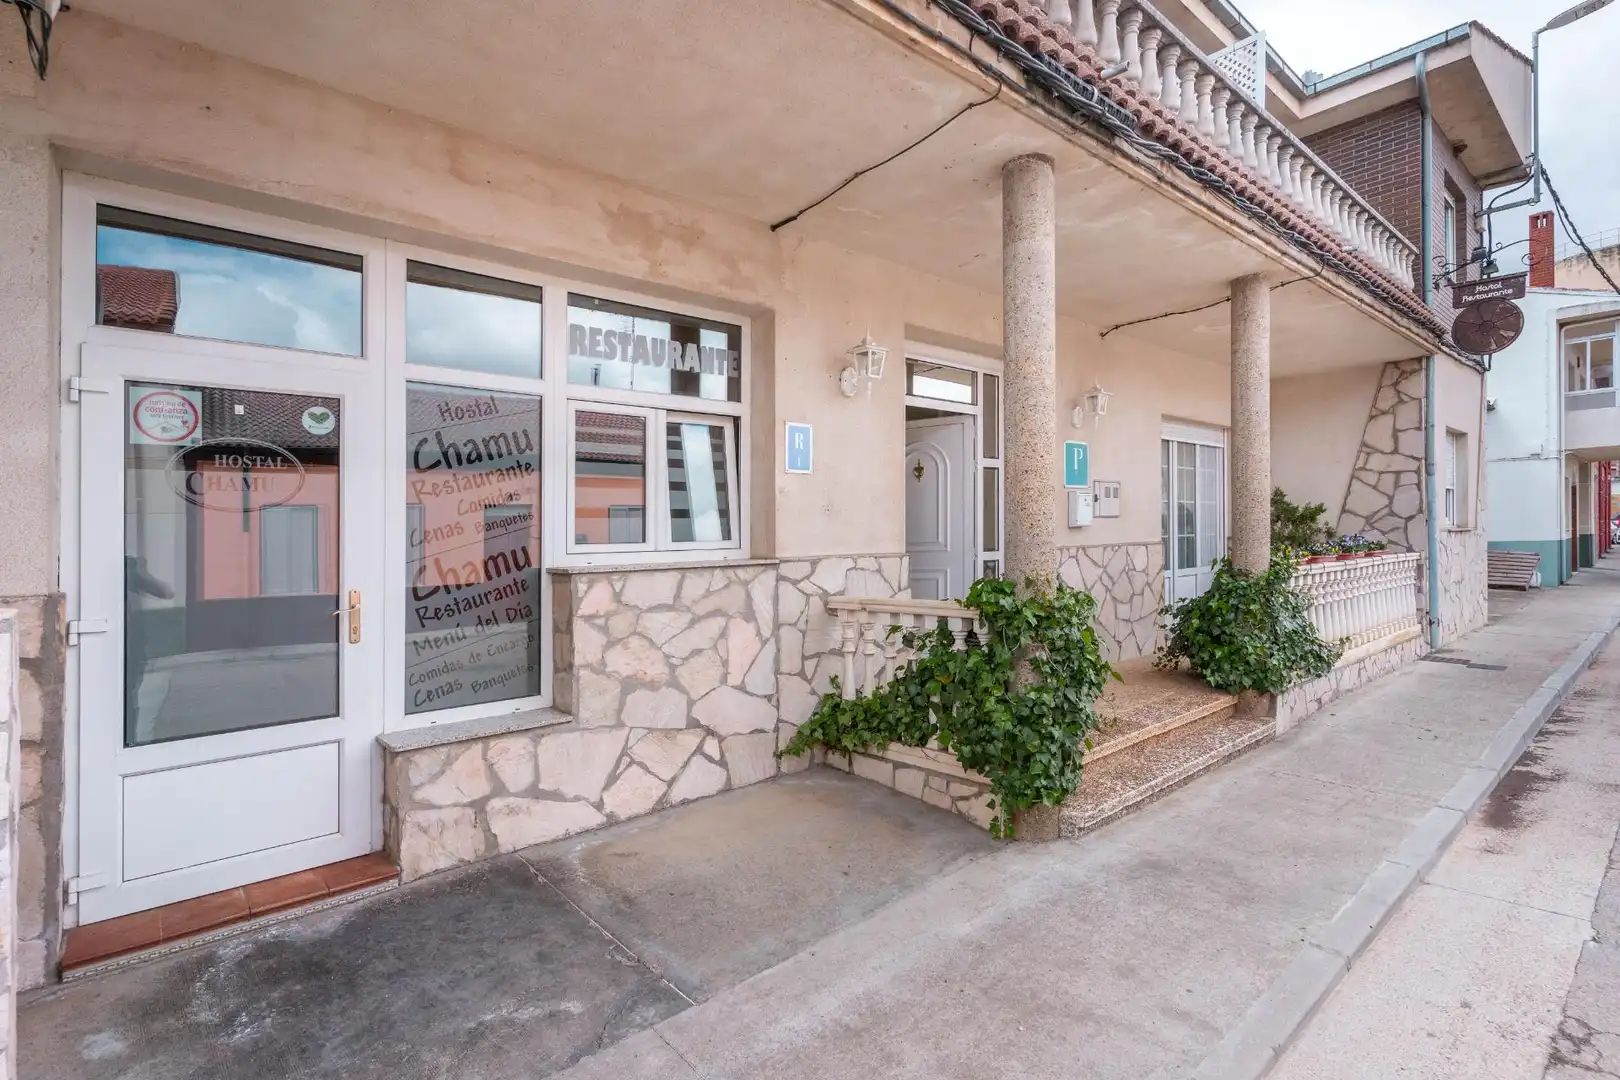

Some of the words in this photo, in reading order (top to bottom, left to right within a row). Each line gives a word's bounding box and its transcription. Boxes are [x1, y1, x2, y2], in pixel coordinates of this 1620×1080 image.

[1462, 288, 1513, 303] Restaurante
[1475, 281, 1502, 293] Hostal
[569, 322, 740, 378] RESTAURANTE
[437, 395, 500, 422] Hostal
[413, 429, 534, 473] Chamu
[795, 432, 804, 450] R
[1071, 447, 1084, 470] P
[214, 454, 288, 470] HOSTAL
[185, 471, 276, 496] CHAMU
[411, 460, 535, 504] Restaurante
[457, 488, 522, 516] Comidas
[410, 521, 465, 548] Cenas
[474, 511, 535, 535] Banquetes
[412, 545, 533, 602] Chamu
[415, 577, 530, 628] Restaurante
[412, 622, 467, 656] Menú
[475, 611, 499, 635] del
[505, 602, 533, 623] Día
[409, 659, 464, 686] Comidas
[468, 650, 482, 664] de
[487, 634, 534, 657] Encargo
[414, 678, 463, 707] Cenas
[471, 663, 534, 694] Banquetes
